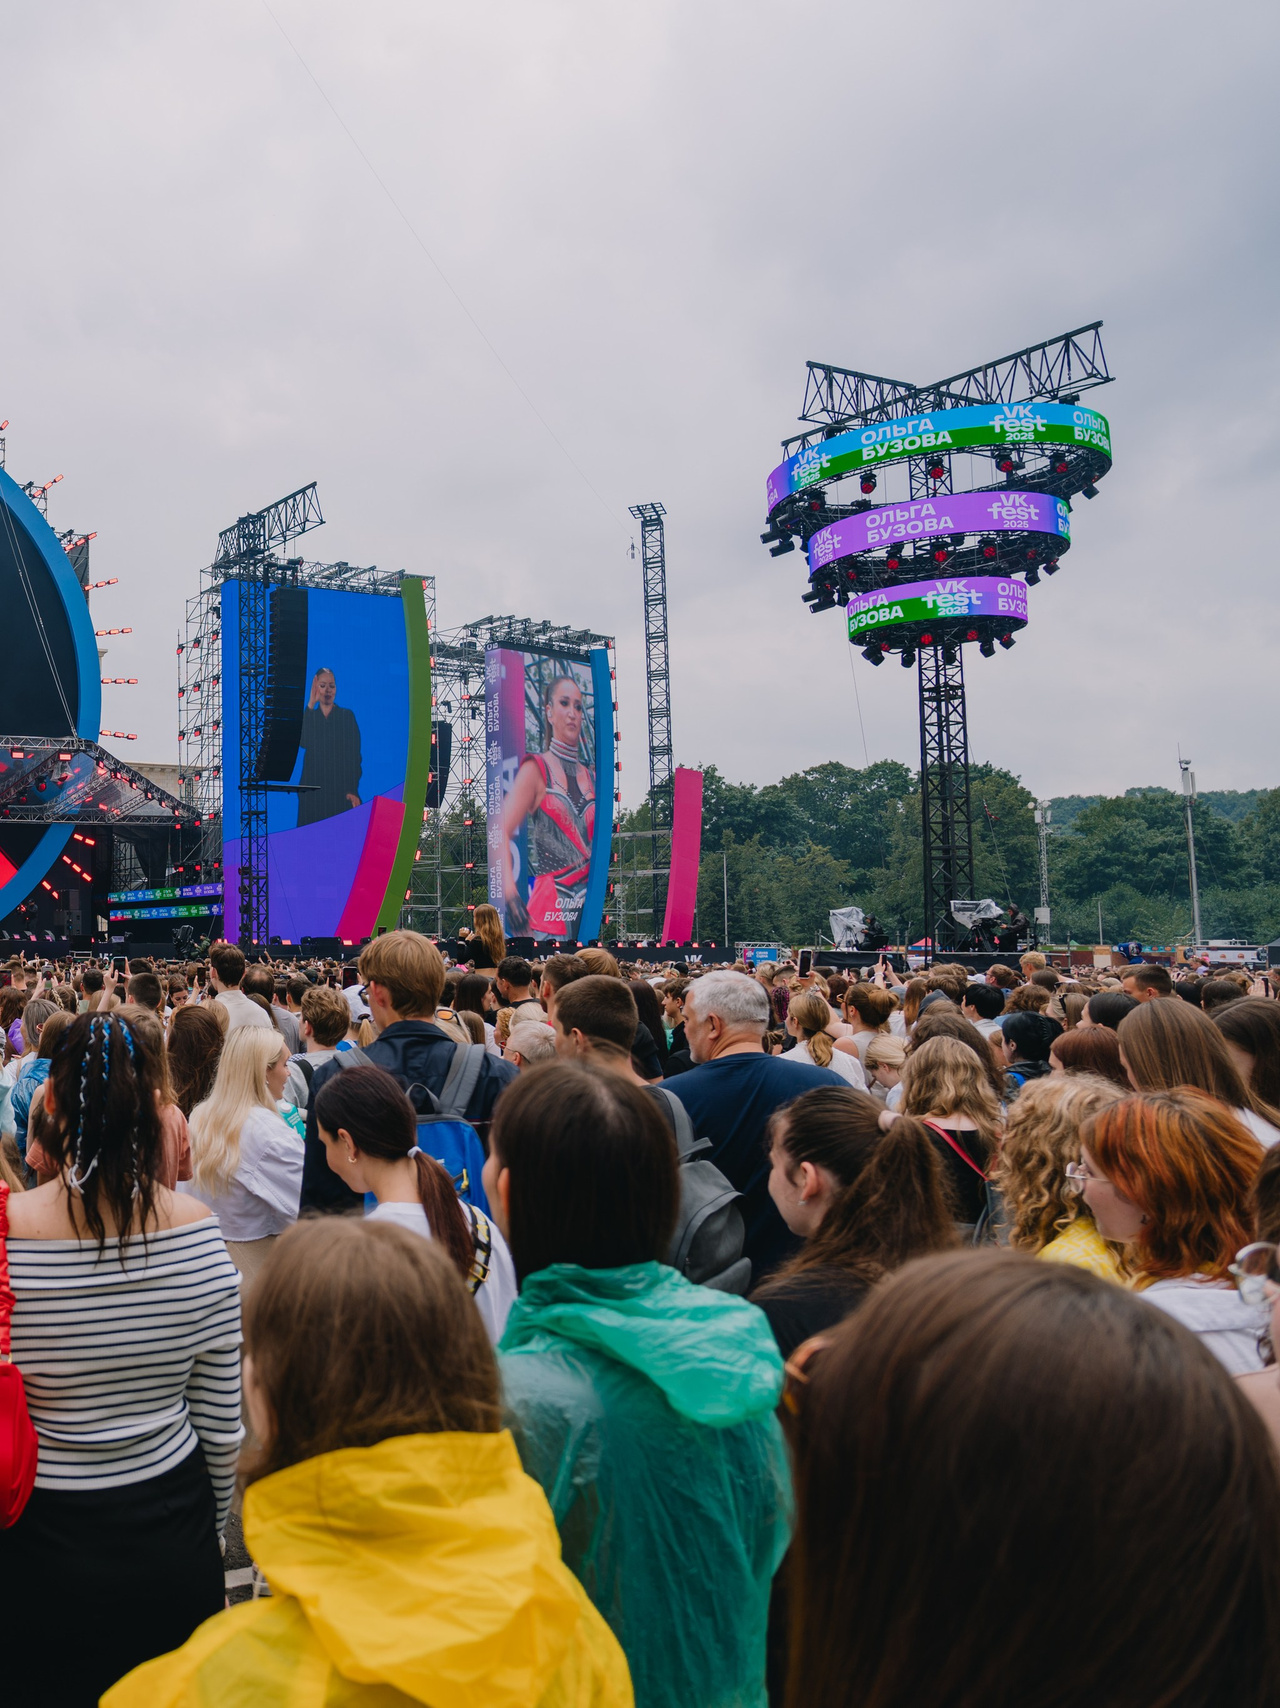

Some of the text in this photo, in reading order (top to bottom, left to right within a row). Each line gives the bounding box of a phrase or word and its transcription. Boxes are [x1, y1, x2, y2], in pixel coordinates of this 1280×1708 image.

[1002, 405, 1034, 418] VK
[861, 418, 934, 445] ОЛЬГА
[989, 415, 1048, 433] fest
[1073, 410, 1107, 435] ОЛЬГА
[1005, 432, 1035, 441] 2025
[1074, 426, 1110, 453] БУЗОВ
[862, 431, 953, 461] БУЗОВА
[798, 446, 820, 465] VK
[791, 453, 832, 481] fest
[800, 471, 821, 487] 2025
[1000, 494, 1028, 507] VK
[865, 503, 937, 528] ОЛЬГА
[987, 503, 1040, 520] fest
[867, 516, 954, 543] БУЗОВА
[1003, 520, 1029, 528] 2025
[816, 528, 833, 544] VK
[813, 534, 842, 560] fest
[935, 580, 968, 593] VK
[997, 582, 1027, 600] ОЛЬГ
[849, 593, 889, 618] ОЛЬГА
[922, 589, 983, 608] fest
[849, 605, 904, 632] БУЗОВА
[937, 606, 969, 616] 2025
[555, 897, 583, 909] ОЛЬГА
[544, 911, 578, 922] БУЗОВА
